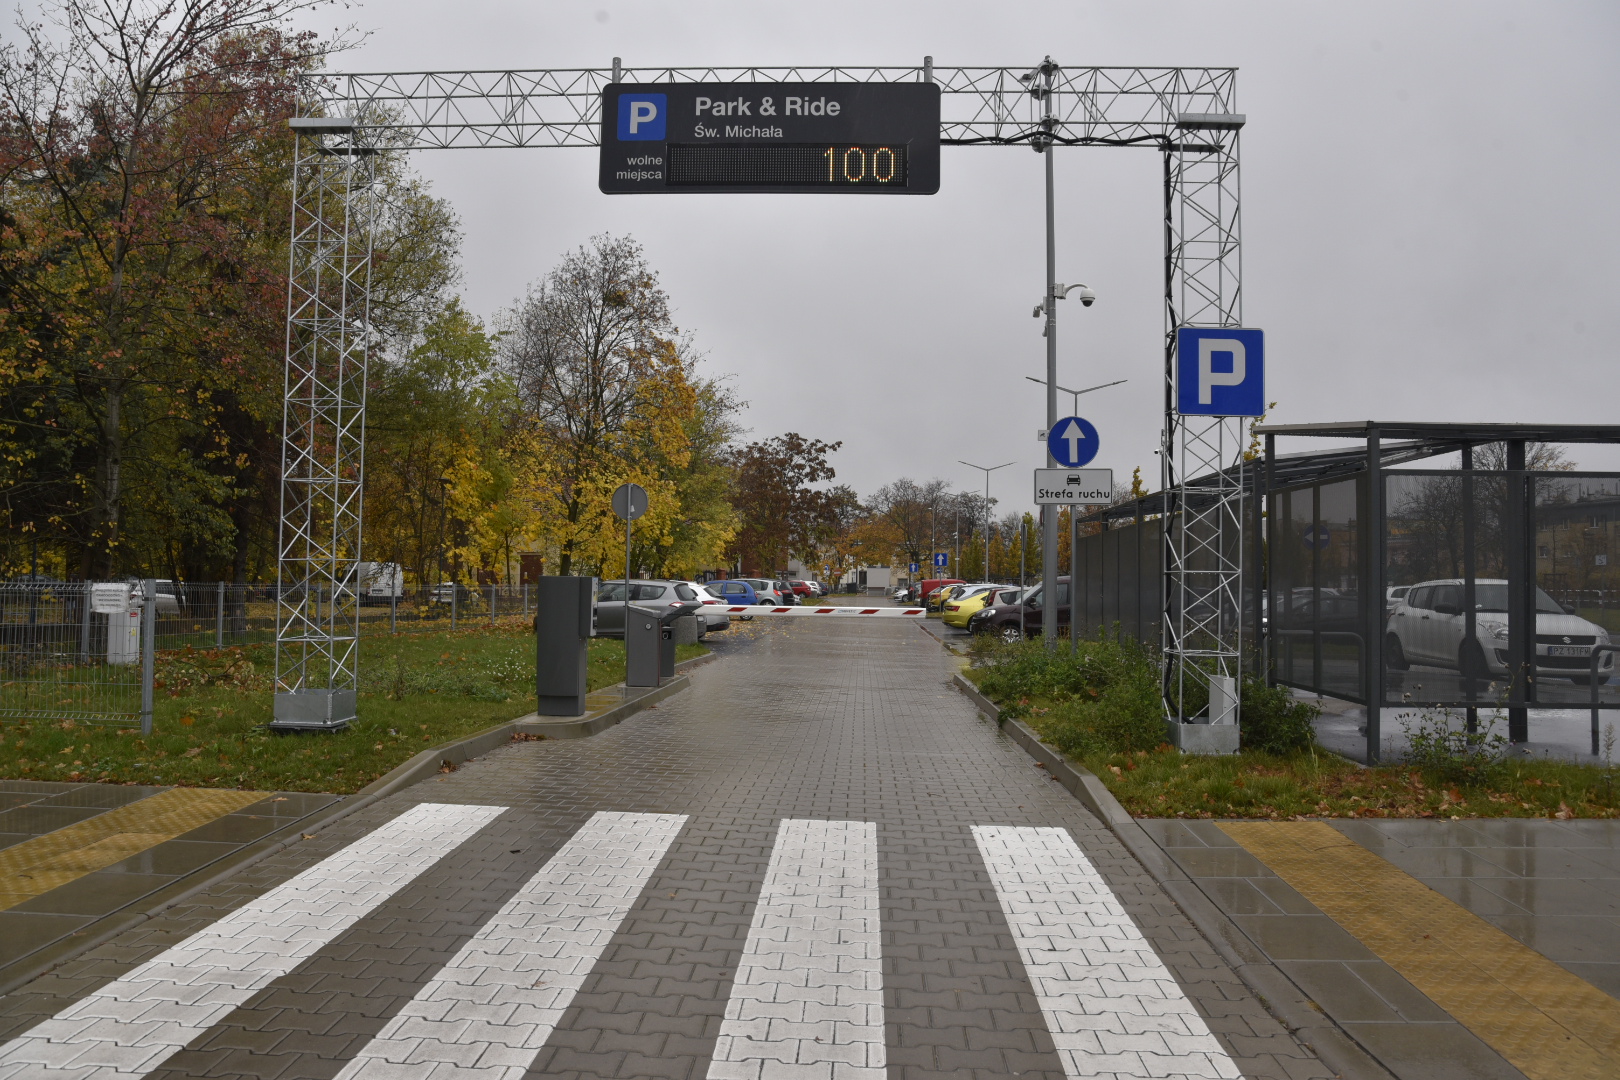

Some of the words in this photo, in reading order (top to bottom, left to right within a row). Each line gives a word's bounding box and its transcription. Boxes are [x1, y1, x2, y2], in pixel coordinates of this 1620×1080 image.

[696, 97, 751, 116] Park
[760, 97, 776, 116] &
[786, 97, 840, 116] Ride
[630, 102, 657, 133] P
[695, 122, 719, 137] Św.
[726, 126, 783, 137] Michała
[627, 155, 662, 165] wolne
[825, 147, 894, 182] 100
[617, 169, 662, 181] miejsca
[1198, 337, 1246, 405] P
[1038, 488, 1073, 499] Strefa
[1078, 488, 1109, 499] ruchu
